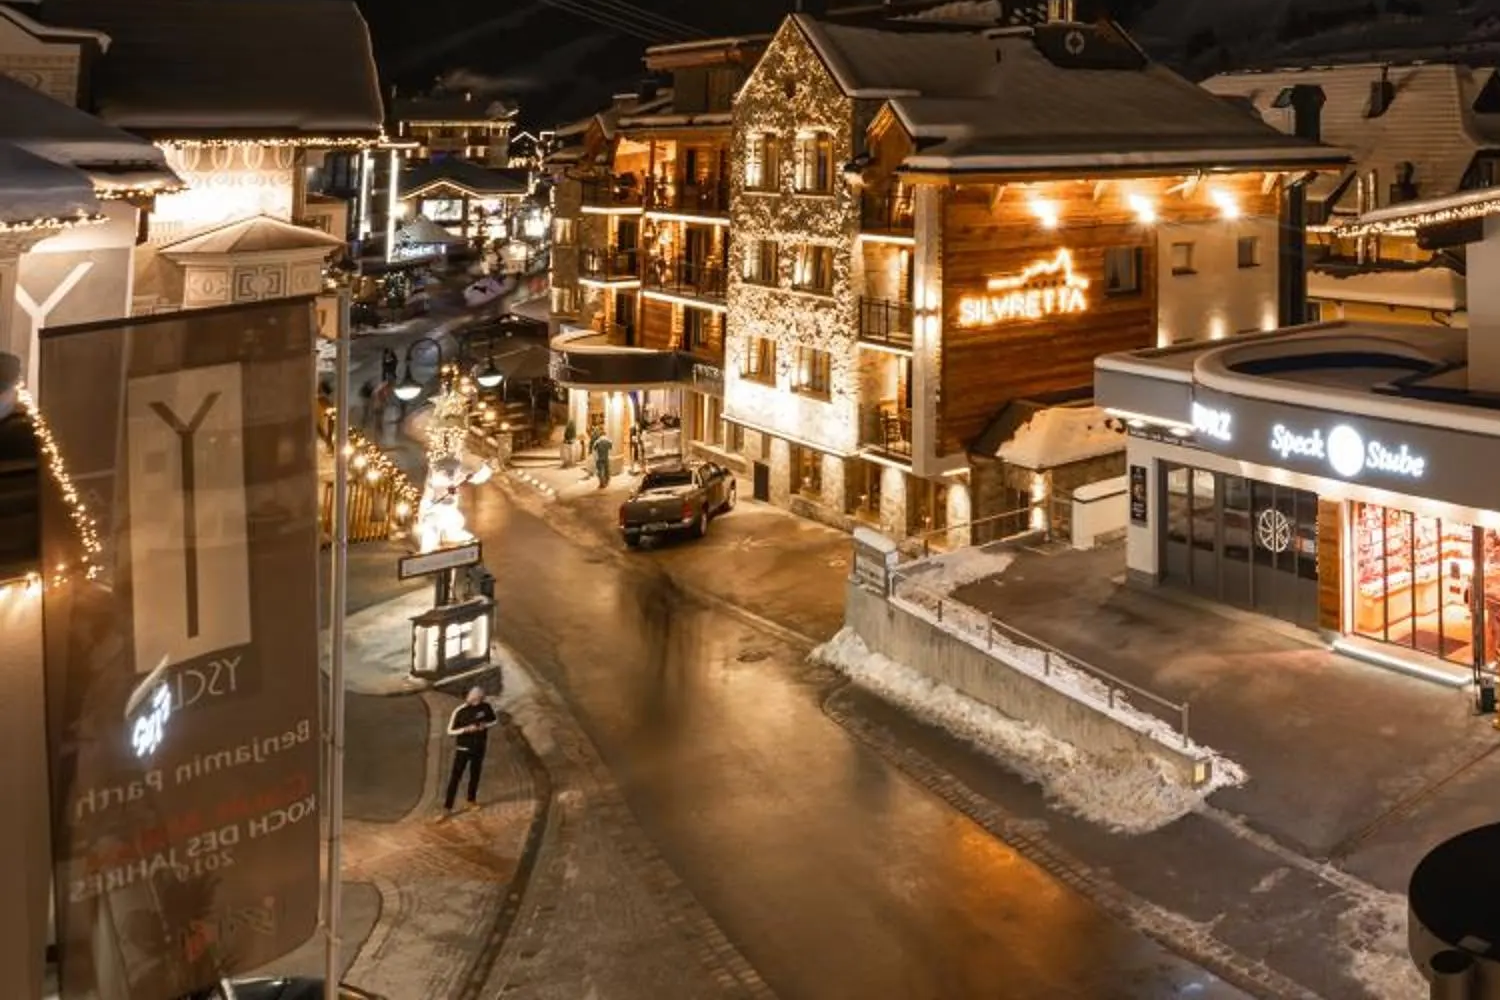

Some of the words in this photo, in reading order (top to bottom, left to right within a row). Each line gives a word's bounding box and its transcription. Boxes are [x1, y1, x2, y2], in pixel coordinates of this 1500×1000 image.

[959, 287, 1088, 327] SILVRETTA
[1271, 423, 1325, 459] Speck
[1366, 440, 1426, 477] Stube
